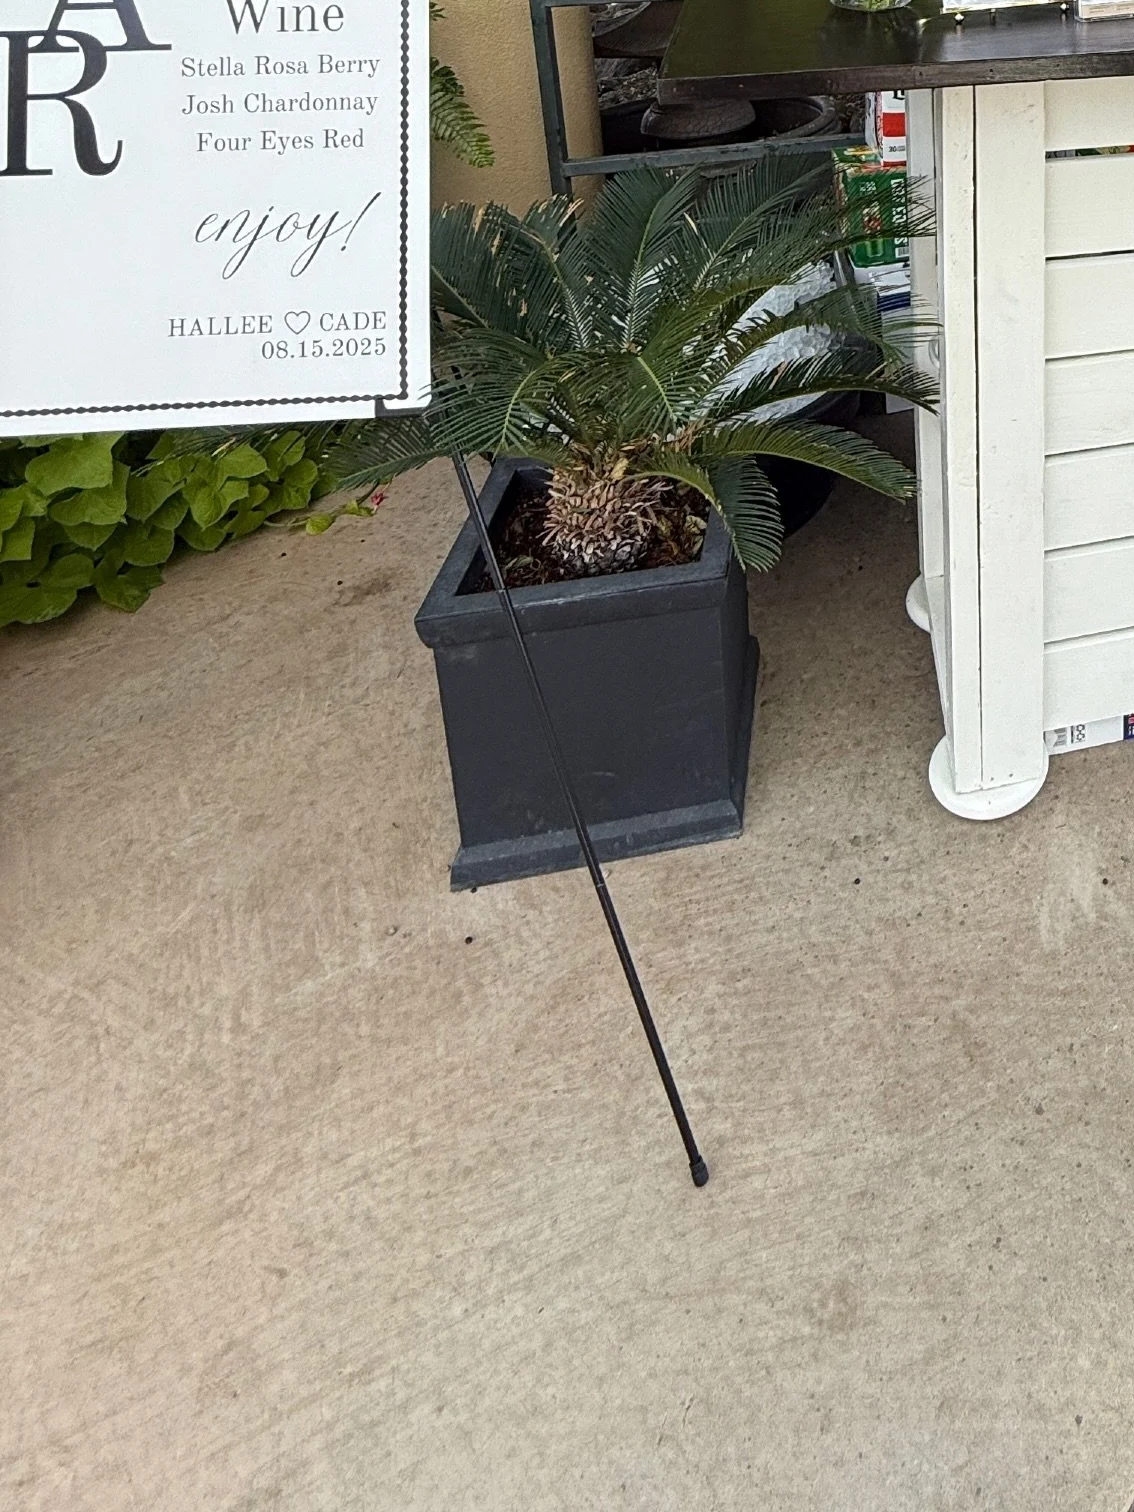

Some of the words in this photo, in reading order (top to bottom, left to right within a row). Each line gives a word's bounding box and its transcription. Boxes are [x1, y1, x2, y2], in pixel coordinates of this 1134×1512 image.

[181, 56, 245, 77] Stella
[254, 55, 309, 76] Rosa
[317, 54, 380, 78] Berry
[182, 93, 234, 115] Josh
[244, 92, 379, 116] Chardonnay
[196, 131, 252, 152] Four
[260, 130, 314, 156] Eyes
[322, 128, 365, 149] Red
[195, 191, 382, 280] enjoy!
[168, 315, 273, 337] HALLEE
[319, 311, 387, 332] CADE
[261, 337, 386, 360] 08.15.2025
